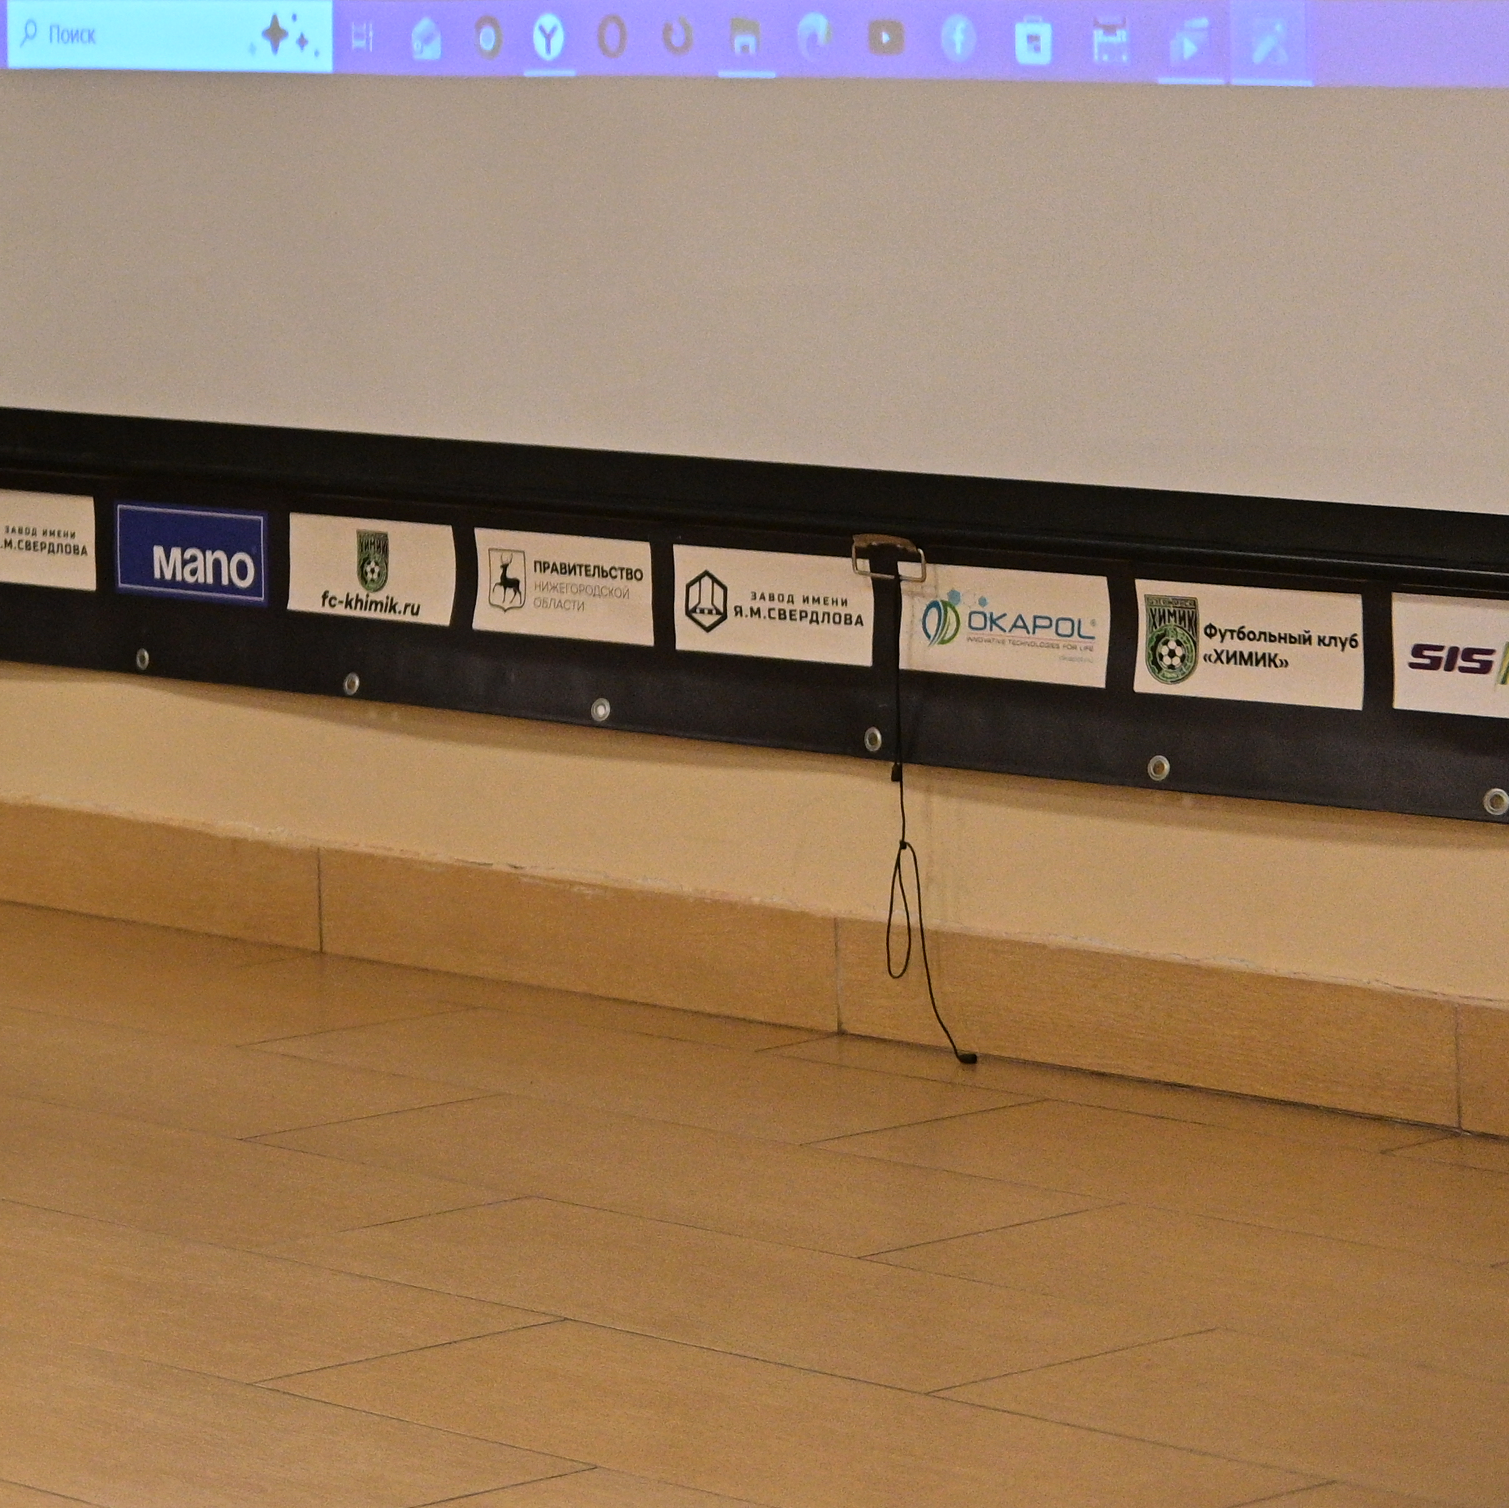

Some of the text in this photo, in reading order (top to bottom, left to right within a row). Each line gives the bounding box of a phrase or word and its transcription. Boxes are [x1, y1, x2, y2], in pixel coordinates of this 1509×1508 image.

[49, 23, 96, 45] Поиск
[4, 525, 77, 539] ЗАВОД ИМЕНИ
[532, 559, 645, 582] ПРАВИТЕЛЬСТВО
[533, 580, 631, 600] НИЖЕГОРОДСКОЙ
[749, 591, 850, 608] ЗАВОД ИМЕНИ
[321, 589, 422, 618] fc-khimik.ru
[532, 596, 586, 613] ОБЛАСТИ
[732, 605, 865, 628] Я.М.СВЕРДЛОВА
[1203, 623, 1360, 652] Футбольный клуб
[1202, 648, 1290, 669] «ХИМИК»
